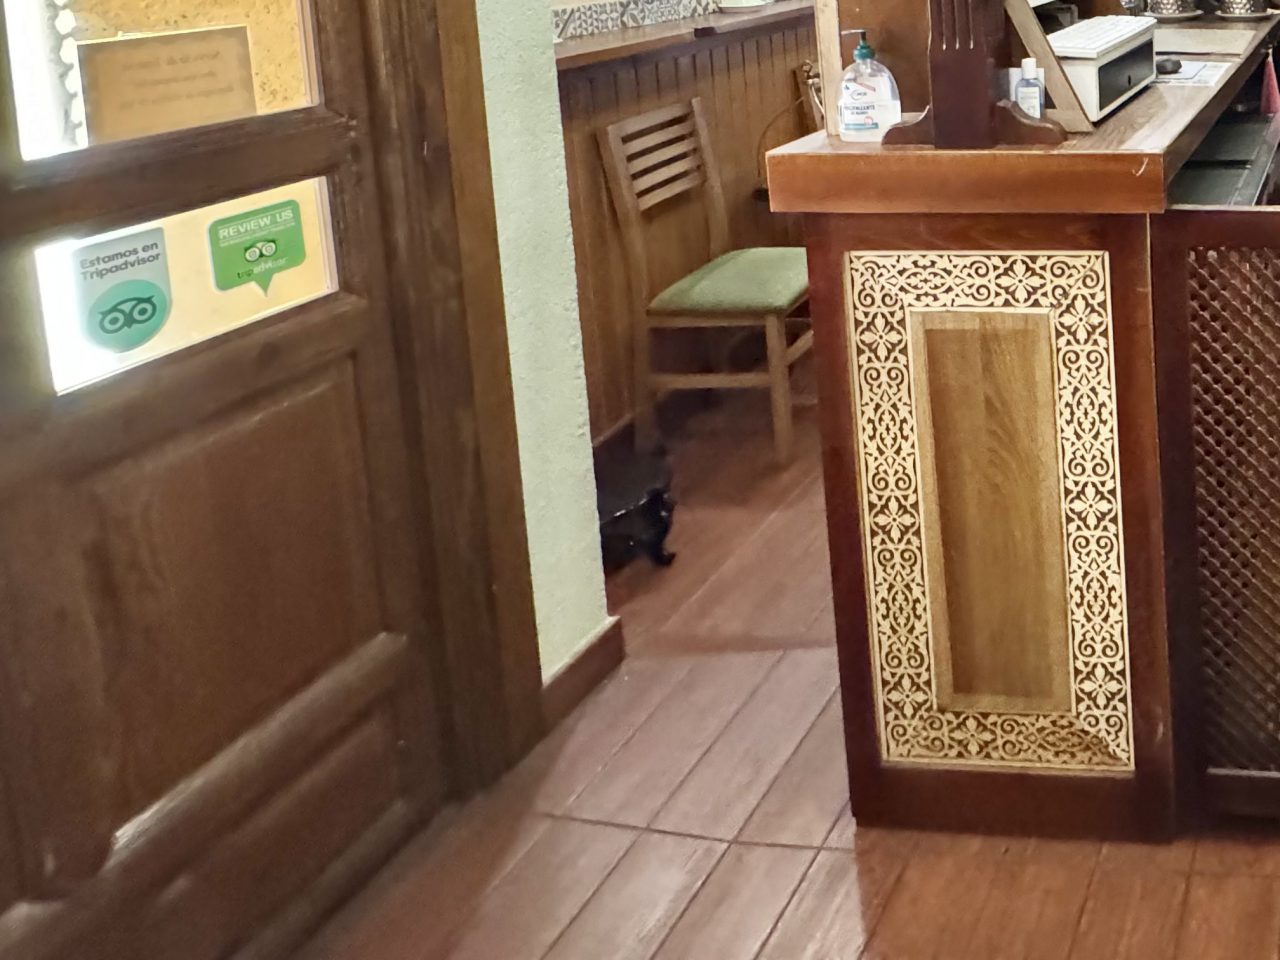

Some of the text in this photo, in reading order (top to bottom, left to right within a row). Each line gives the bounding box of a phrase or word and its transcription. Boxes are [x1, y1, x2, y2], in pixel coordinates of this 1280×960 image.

[218, 215, 272, 240] REVIEW
[275, 209, 294, 223] US
[80, 242, 159, 270] Estamos en
[80, 253, 161, 280] Tripadvisor
